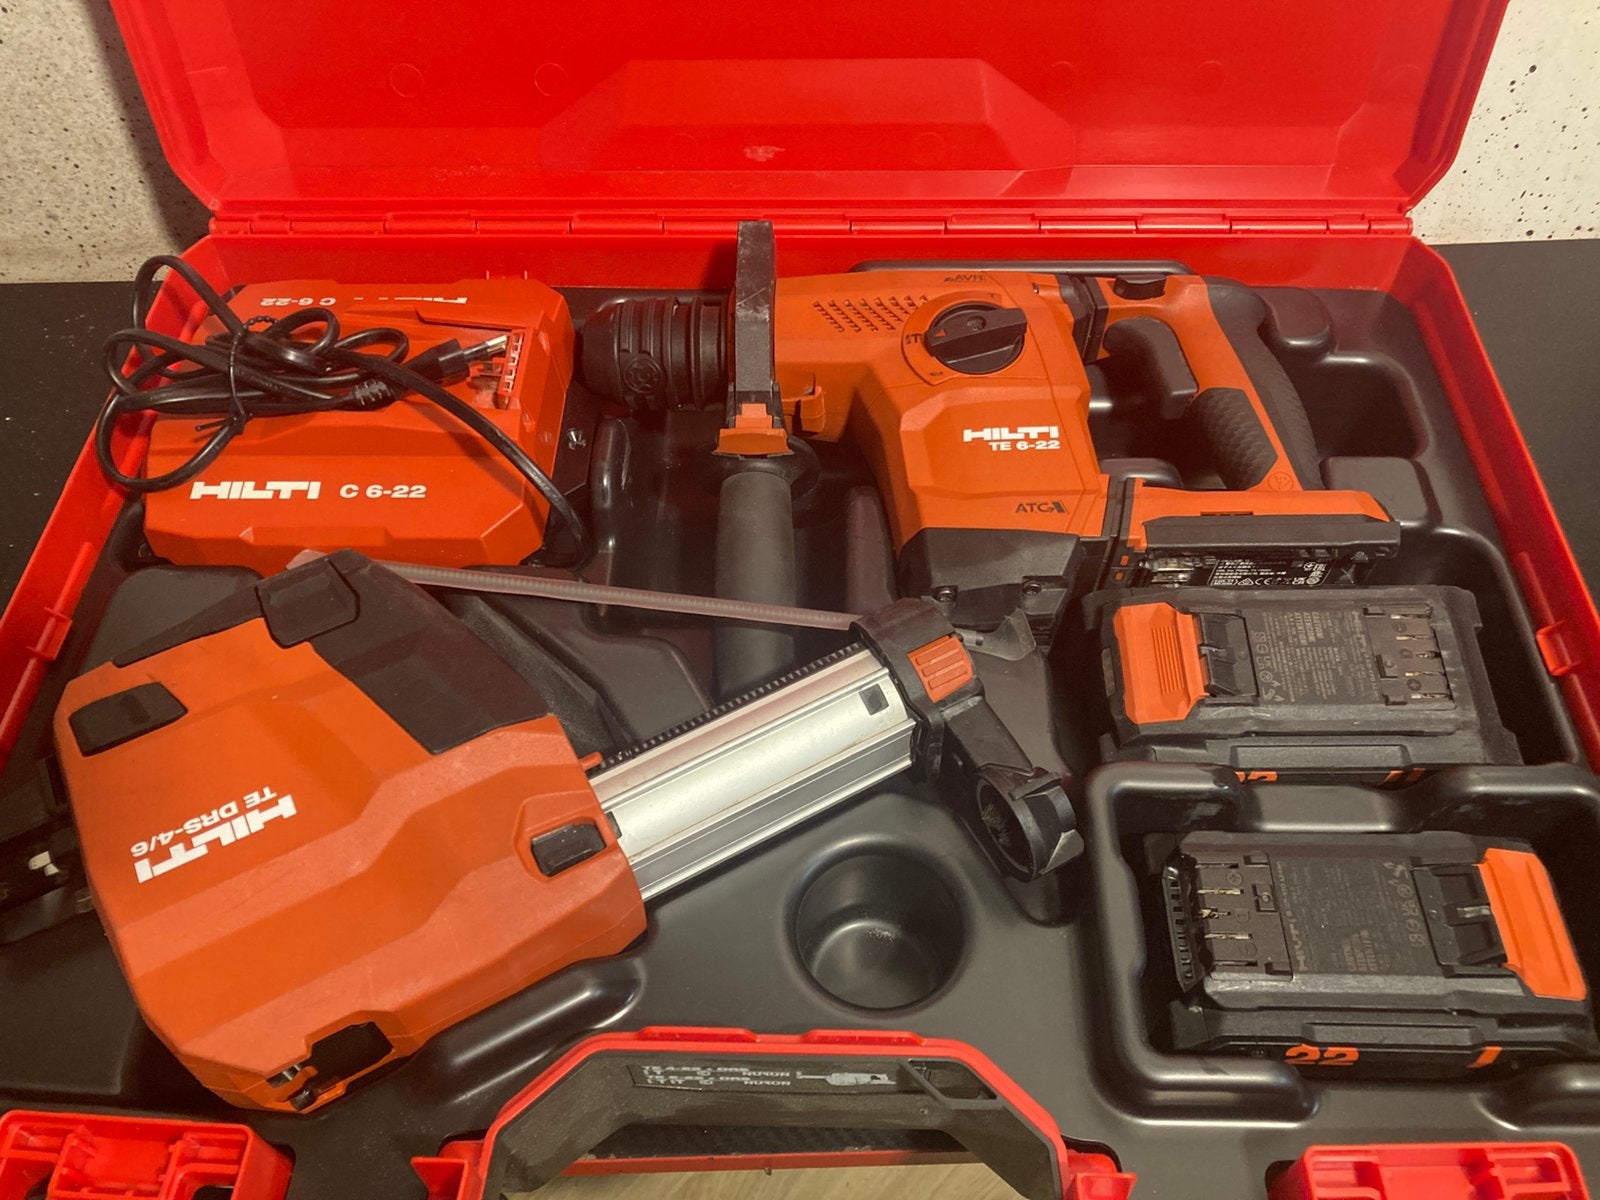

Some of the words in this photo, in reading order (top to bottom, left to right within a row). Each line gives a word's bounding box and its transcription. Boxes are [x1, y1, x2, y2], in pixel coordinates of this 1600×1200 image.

[260, 297, 314, 307] 6-22
[319, 297, 336, 307] C
[962, 425, 1060, 442] HILTI
[988, 441, 1013, 452] TE
[1015, 440, 1062, 451] 6-22
[189, 481, 322, 499] HILTI
[339, 483, 360, 498] C
[365, 483, 428, 498] 6-22
[242, 785, 278, 809] TE
[130, 801, 239, 857] DRS-4/6
[133, 793, 298, 884] HILTI
